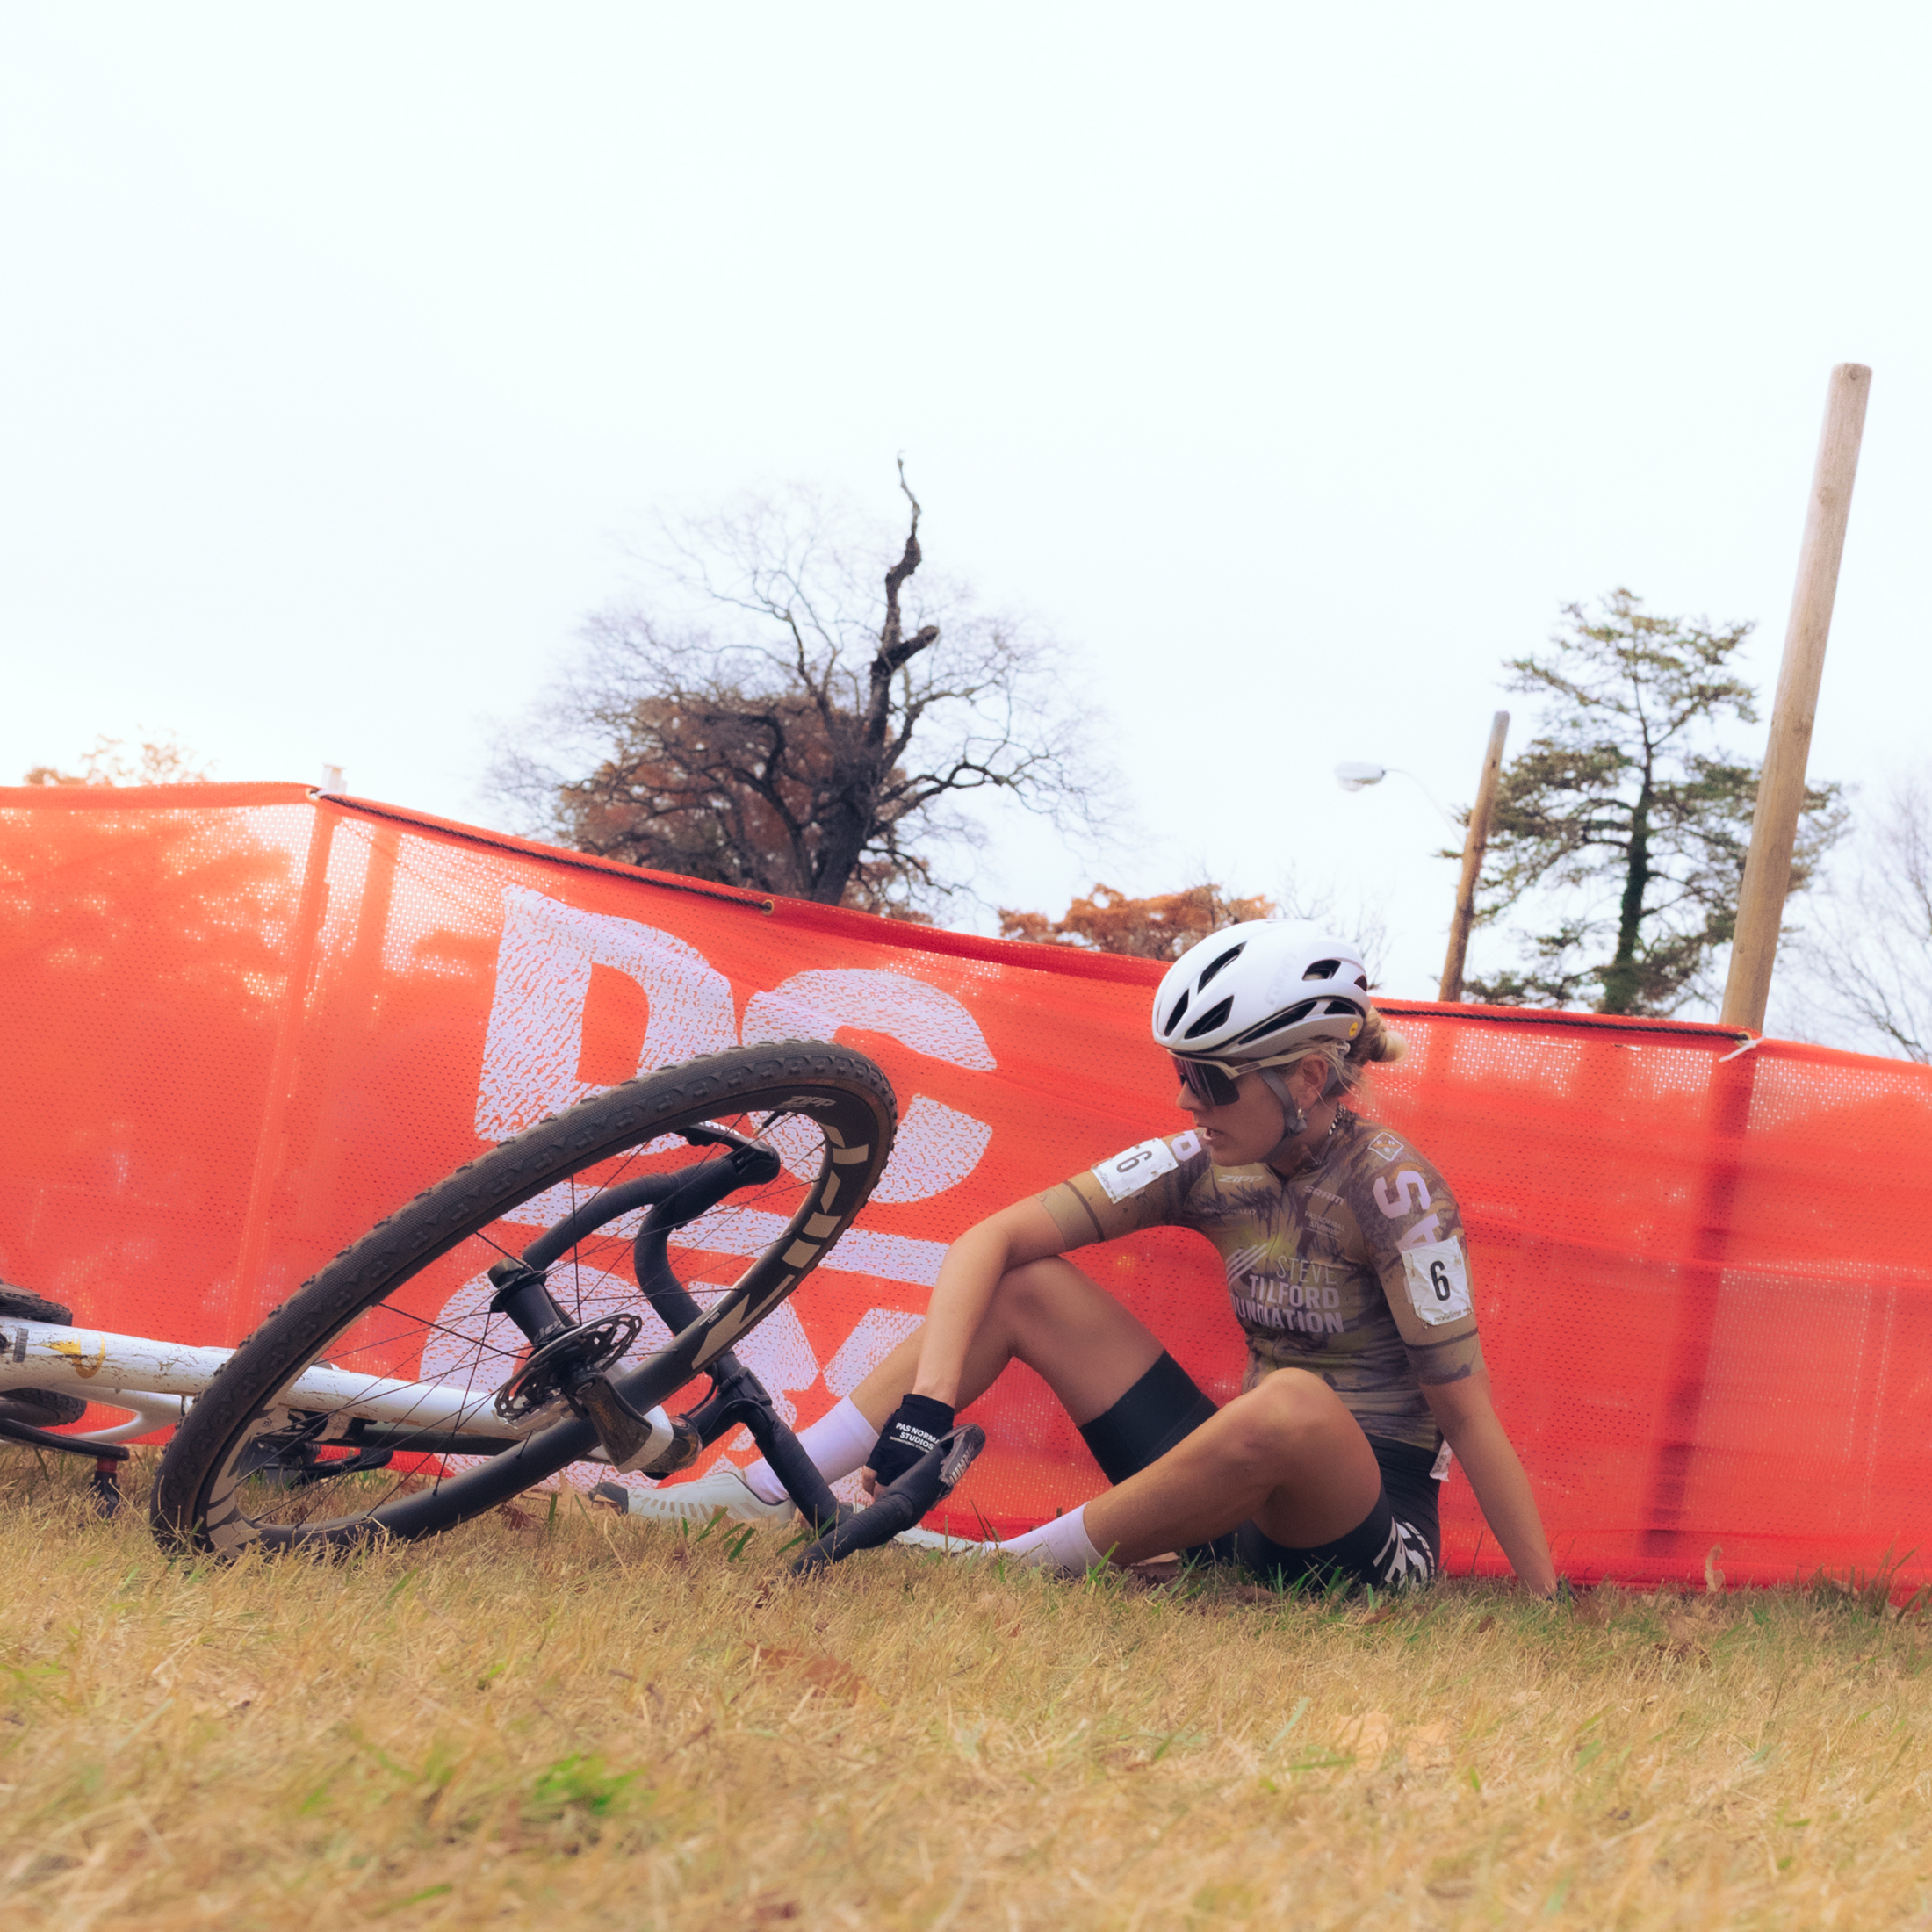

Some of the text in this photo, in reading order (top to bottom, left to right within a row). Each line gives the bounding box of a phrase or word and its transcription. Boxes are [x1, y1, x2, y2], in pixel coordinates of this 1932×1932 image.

[473, 883, 997, 1204] DC
[790, 1095, 837, 1107] ZIPP
[1116, 1150, 1152, 1173] 6
[1218, 1174, 1264, 1183] ZIPP
[1303, 1185, 1344, 1206] SRAM
[1304, 1210, 1345, 1232] PAS NORMAL
[1276, 1255, 1337, 1285] STEVE
[1430, 1260, 1452, 1301] 6
[1249, 1274, 1340, 1309] TILFORD
[1229, 1293, 1344, 1334] OUNDATION
[896, 1422, 912, 1432] PAS
[899, 1431, 935, 1450] STUDIOS
